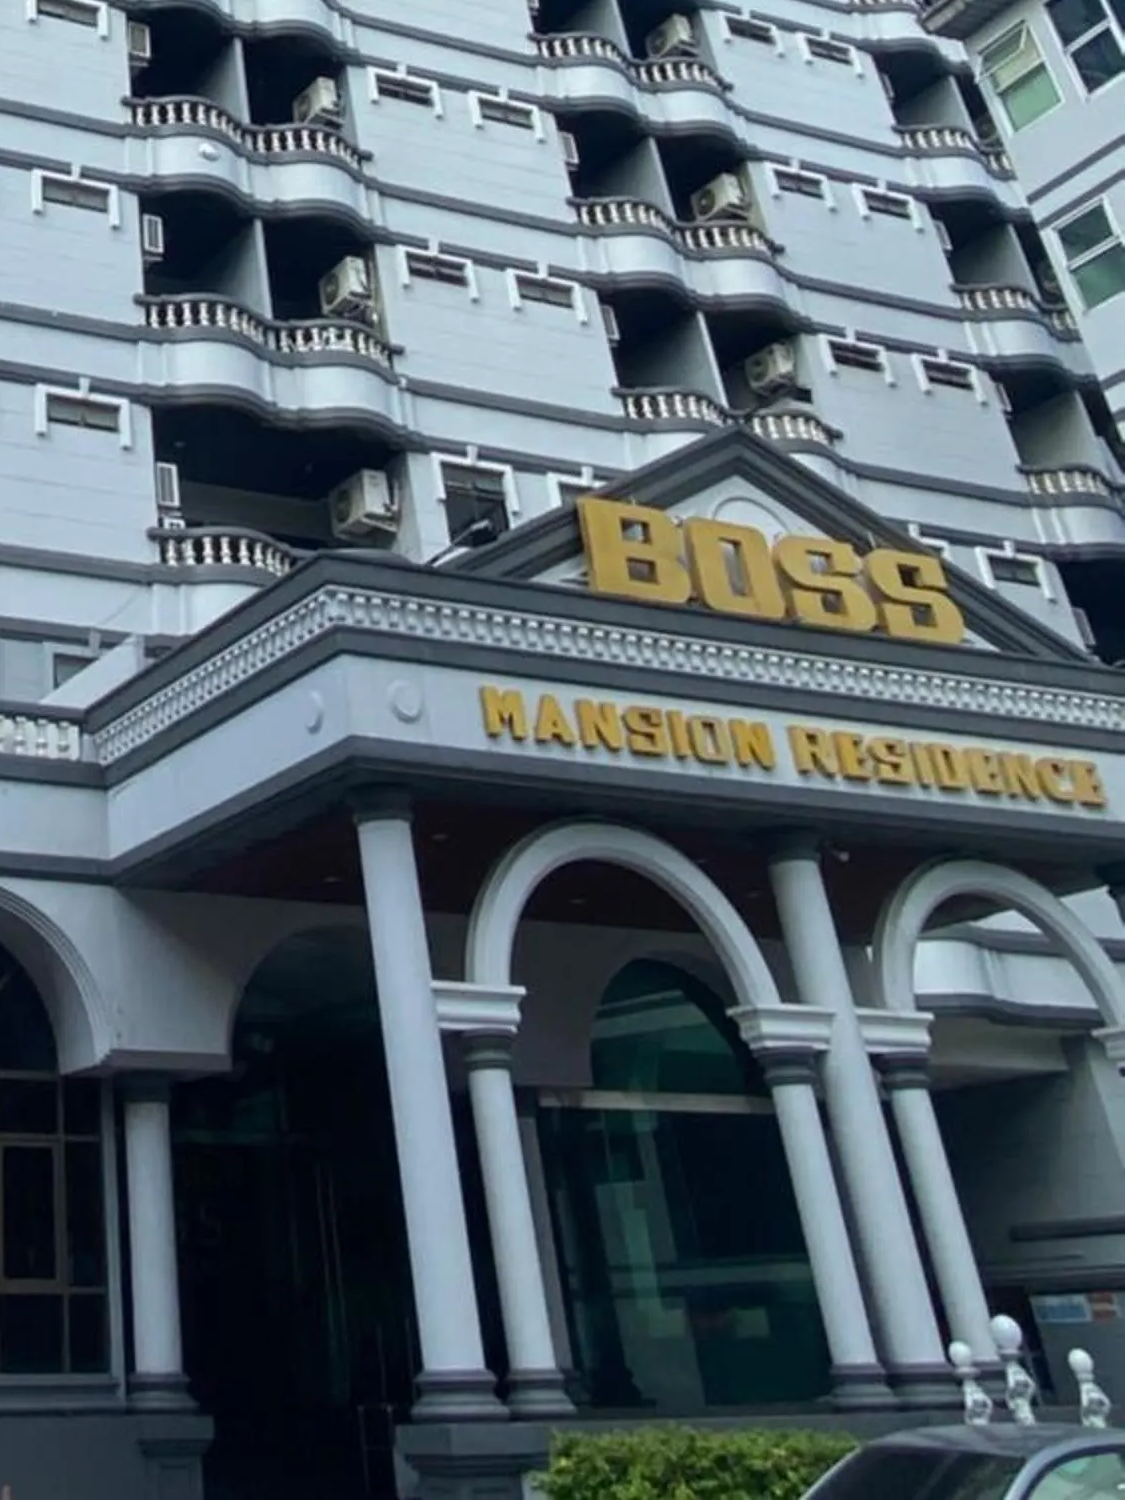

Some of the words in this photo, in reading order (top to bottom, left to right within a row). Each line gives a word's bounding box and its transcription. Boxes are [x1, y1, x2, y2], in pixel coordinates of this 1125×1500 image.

[577, 495, 965, 644] BOSS
[479, 685, 775, 770] MANSION
[788, 724, 1107, 807] RESIDENCE
